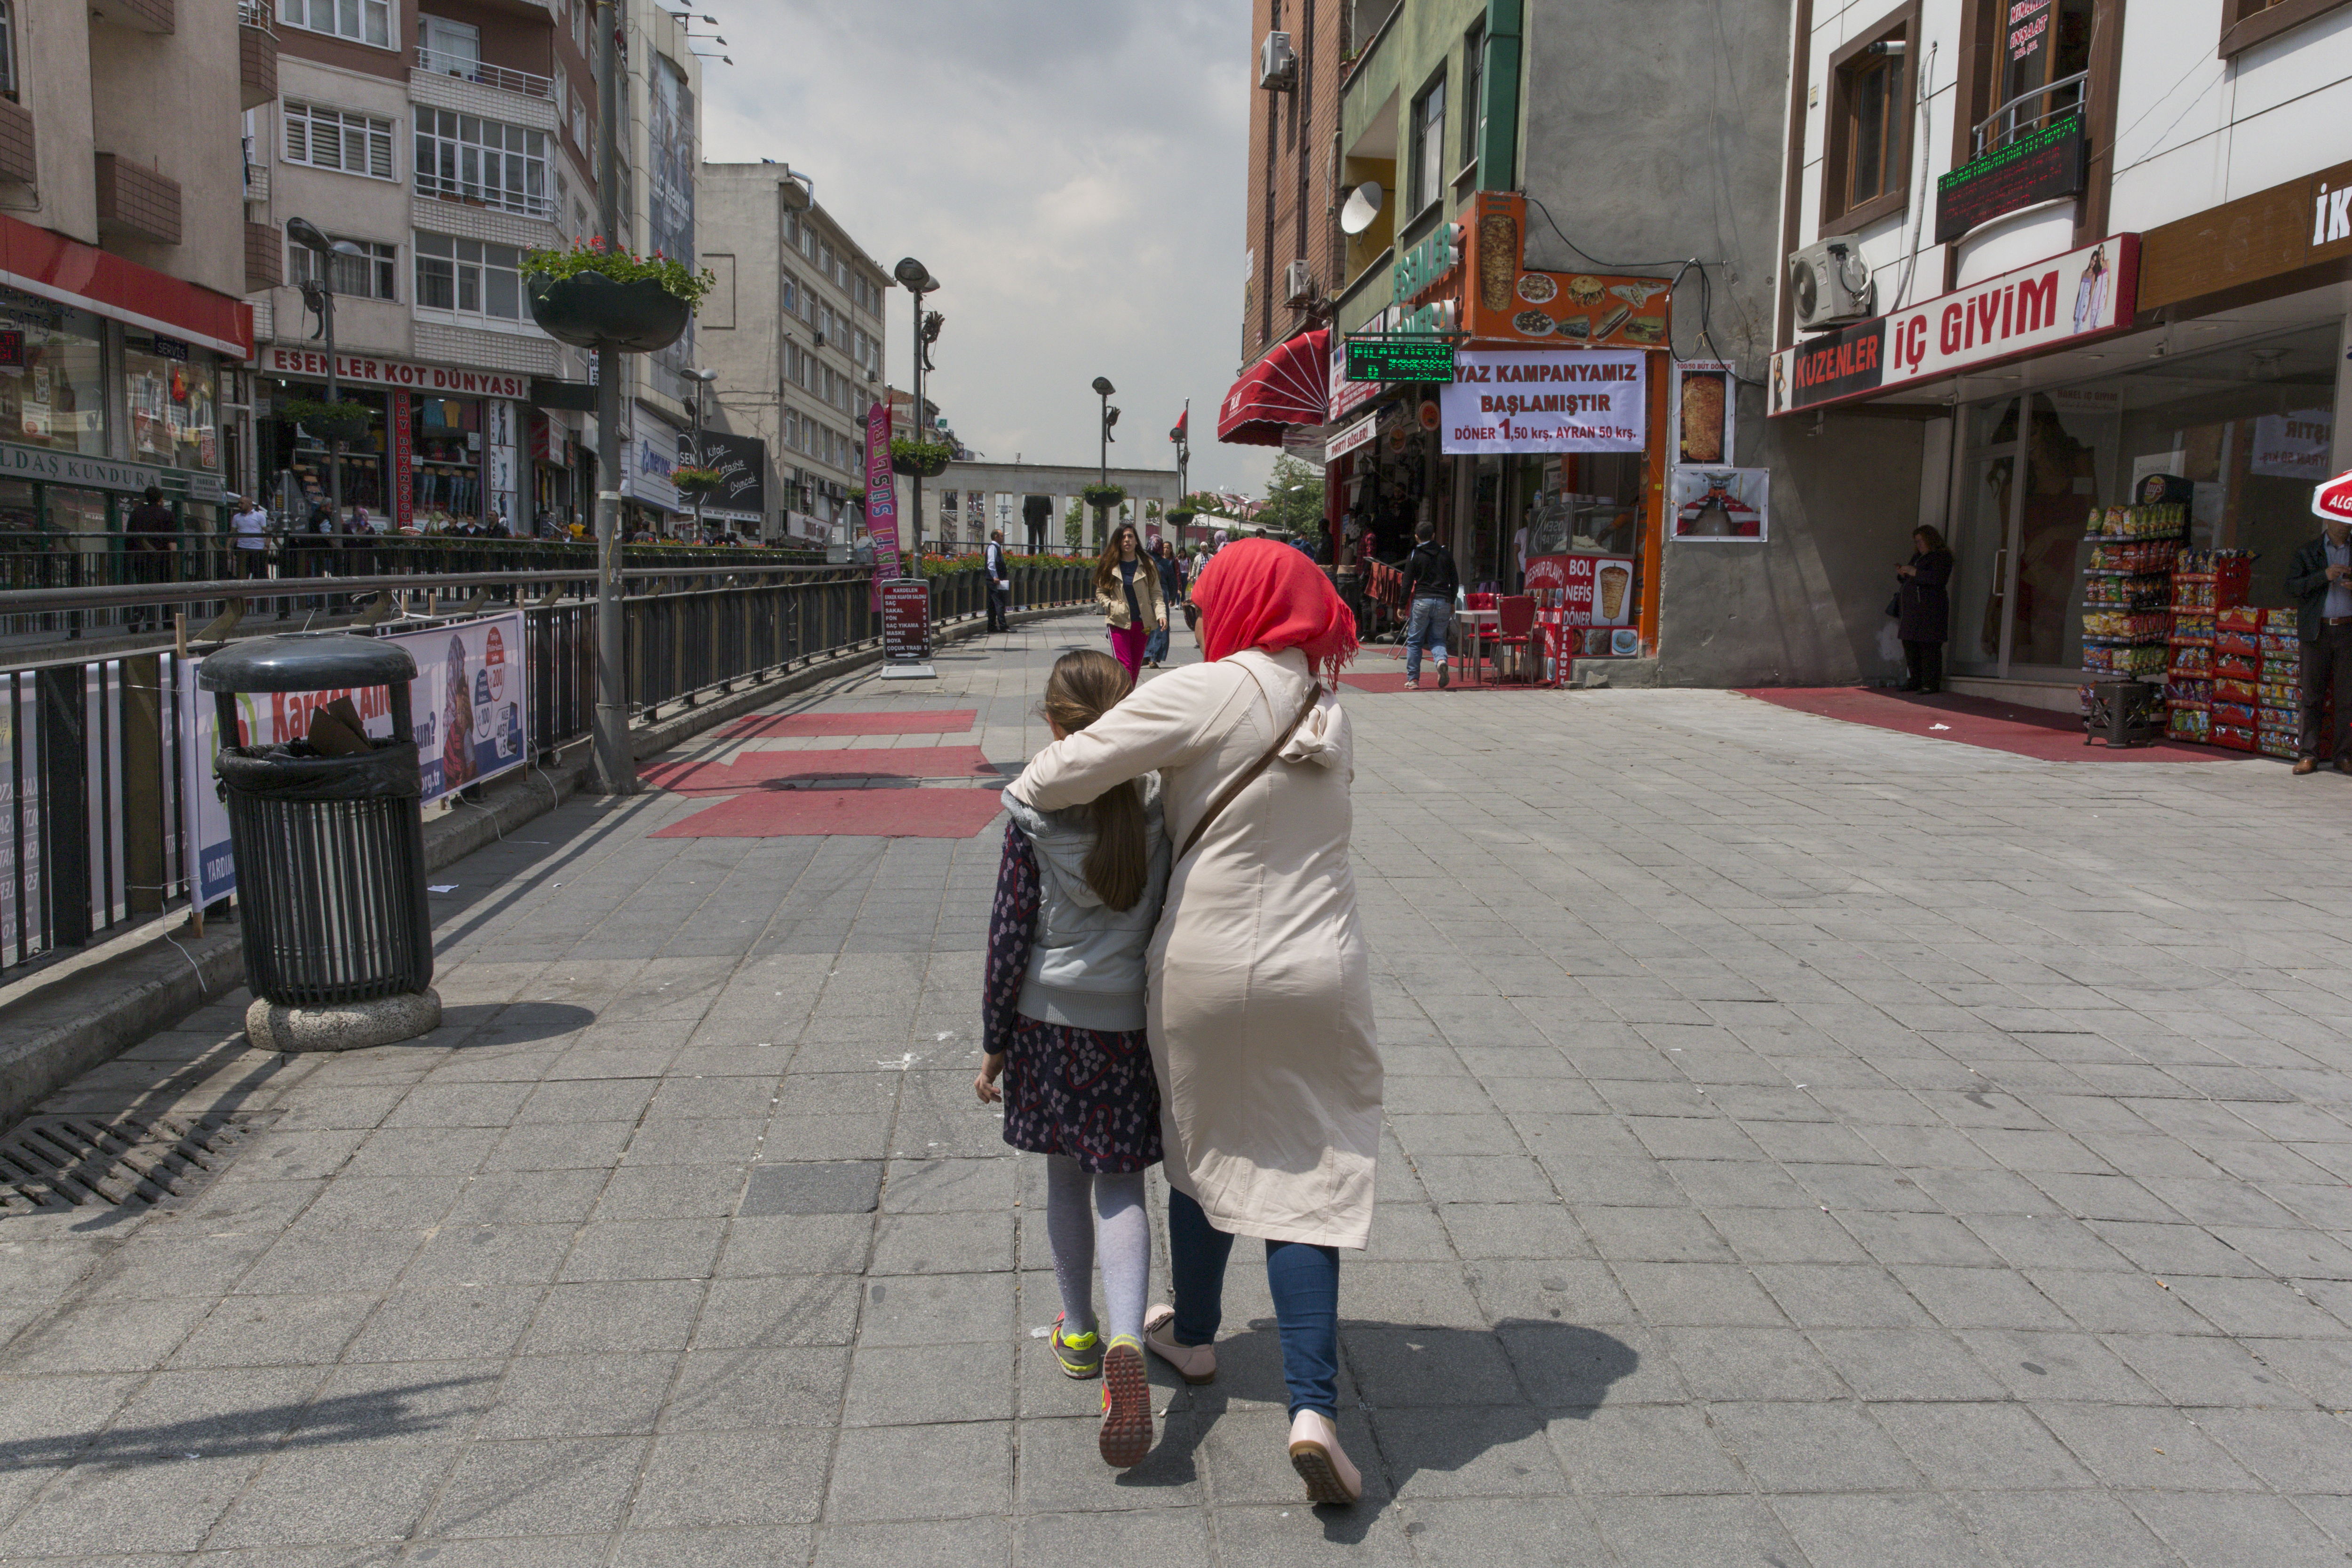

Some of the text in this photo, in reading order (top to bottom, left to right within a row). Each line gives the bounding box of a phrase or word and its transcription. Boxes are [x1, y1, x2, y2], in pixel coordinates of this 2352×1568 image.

[2010, 14, 2048, 49] İNŞAAT
[2014, 47, 2026, 61] LTD.
[655, 170, 664, 197] LC
[2313, 183, 2352, 246] İK
[1393, 224, 1456, 306] ESENLER
[1439, 301, 1446, 330] 2
[1894, 315, 1927, 374] İÇ
[1940, 270, 2059, 356] GİYİM
[274, 350, 522, 396] ESENLER KOT DÜNYASI
[1454, 364, 1637, 383] YAZ KAMPANYAMIZ
[1481, 394, 1611, 416] BAŞLAMIŞTIR
[1331, 424, 1368, 457] PARTİ SÜSLERİ
[1454, 418, 1637, 442] DÖNER 1,50 krş. AYRAN 50 krş.
[398, 394, 410, 527] BAY BAYAN ÇOCUK
[707, 445, 724, 458] Kitap
[68, 461, 157, 486] KUNDURA
[868, 416, 893, 517] SÜSLERİ
[731, 471, 756, 492] Oyuncak
[2328, 494, 2352, 511] ALG
[1525, 558, 1564, 588] MEŞHUR PİLAVCI
[1569, 559, 1591, 576] BOL
[1565, 581, 1592, 603] NEFİS
[1563, 606, 1591, 626] DÖNER
[497, 723, 508, 739] 4031
